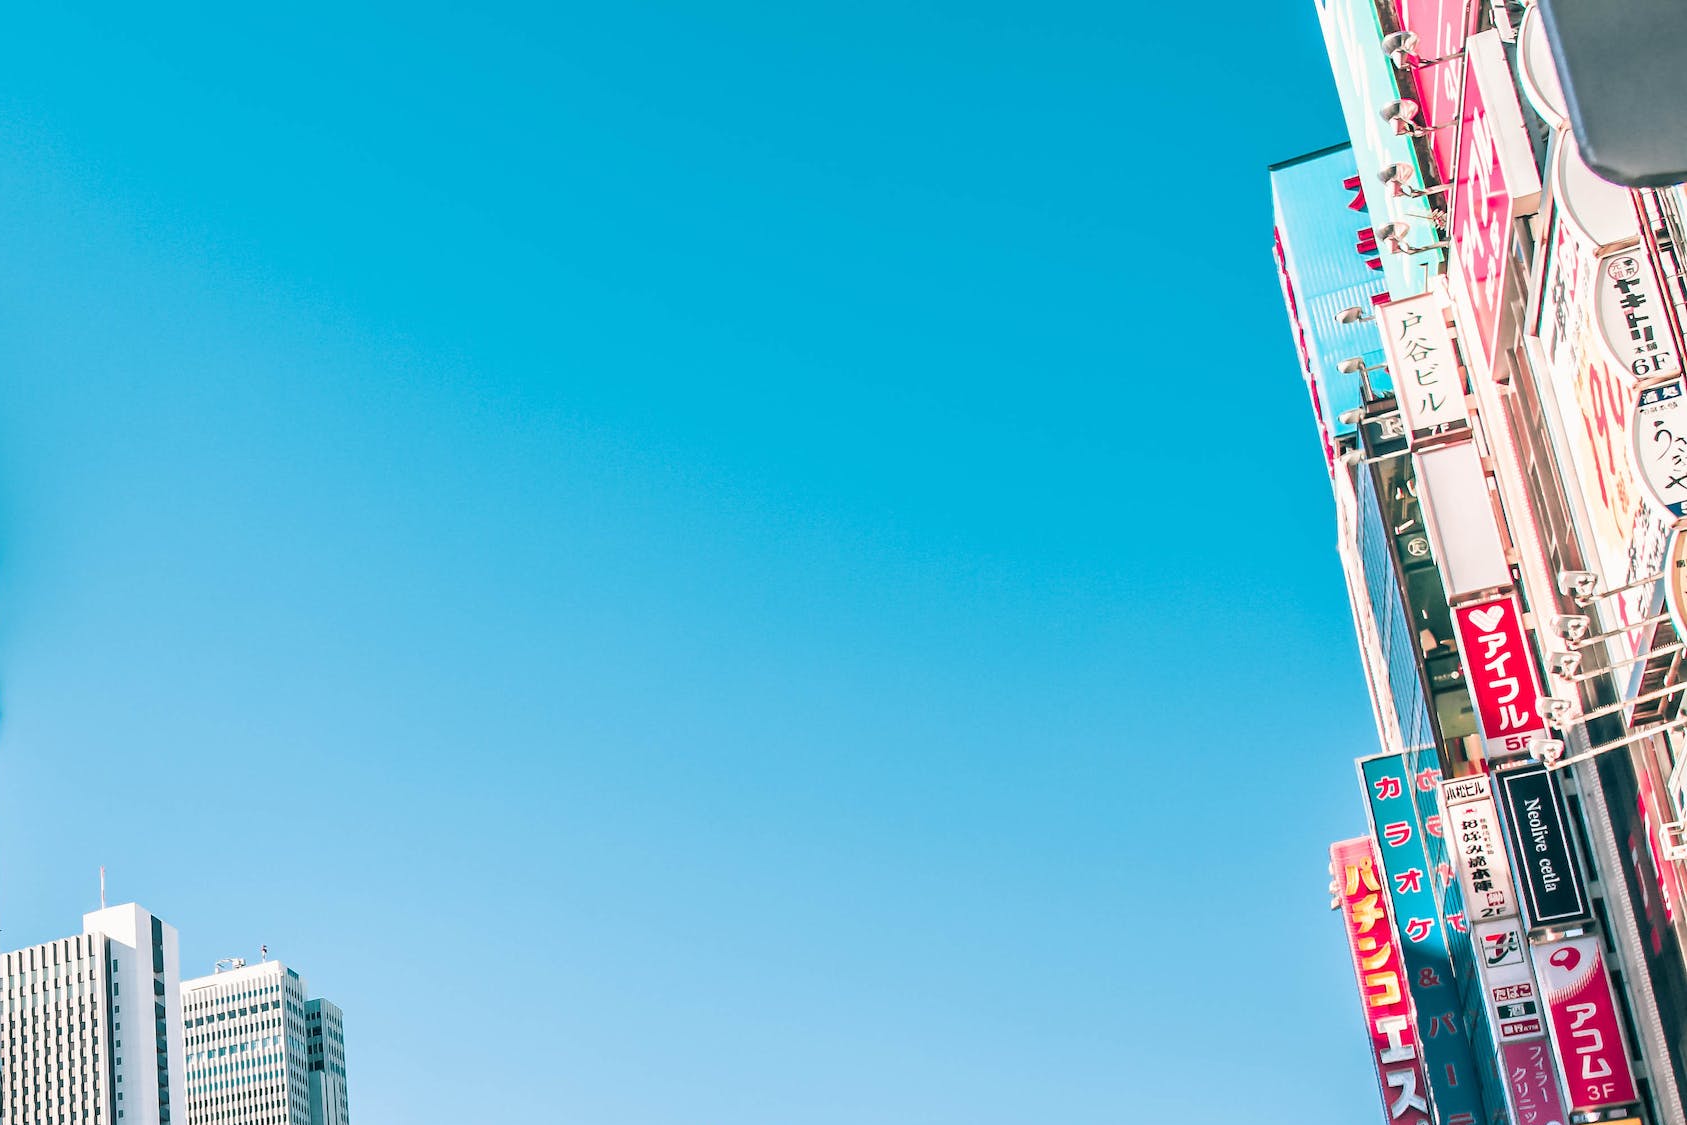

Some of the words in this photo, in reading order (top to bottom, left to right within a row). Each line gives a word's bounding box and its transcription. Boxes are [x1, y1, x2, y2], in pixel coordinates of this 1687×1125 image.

[1400, 312, 1446, 415] 戸谷ビル
[1631, 351, 1672, 376] 6F
[1431, 422, 1450, 436] 7F
[1477, 635, 1529, 732] アイフル
[1446, 776, 1485, 800] 小松ビル
[1524, 798, 1548, 853] Neolive
[1344, 855, 1404, 1007] パチンコ
[1492, 983, 1532, 1000] たばこ
[1565, 1002, 1612, 1081] アコム
[1528, 1046, 1550, 1103] フィラー
[1586, 1083, 1615, 1101] 3F
